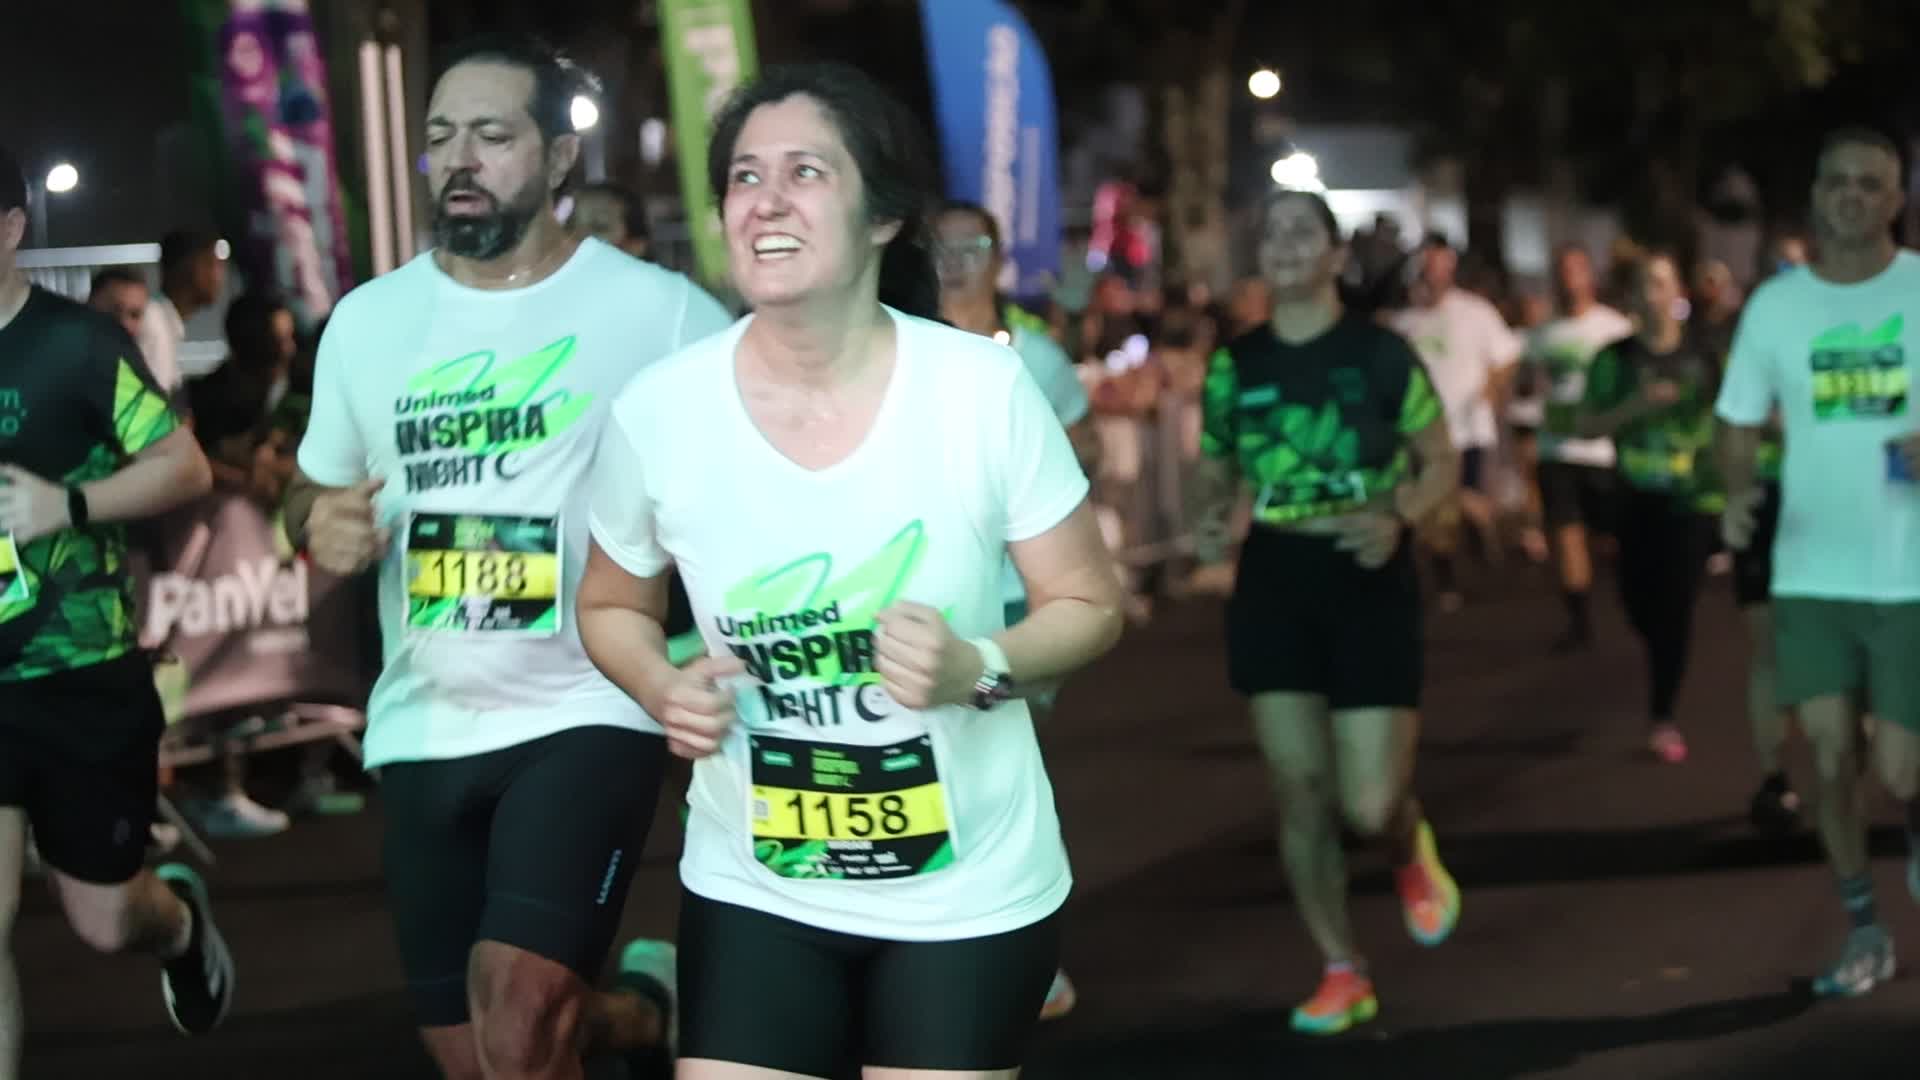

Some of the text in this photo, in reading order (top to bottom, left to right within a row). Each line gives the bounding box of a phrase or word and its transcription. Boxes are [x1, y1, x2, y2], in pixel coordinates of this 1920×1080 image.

[396, 404, 547, 455] INSPIRA
[432, 551, 527, 597] 1188
[715, 600, 841, 637] Unimed
[727, 629, 875, 683] INSPIR
[787, 793, 909, 838] 1158
